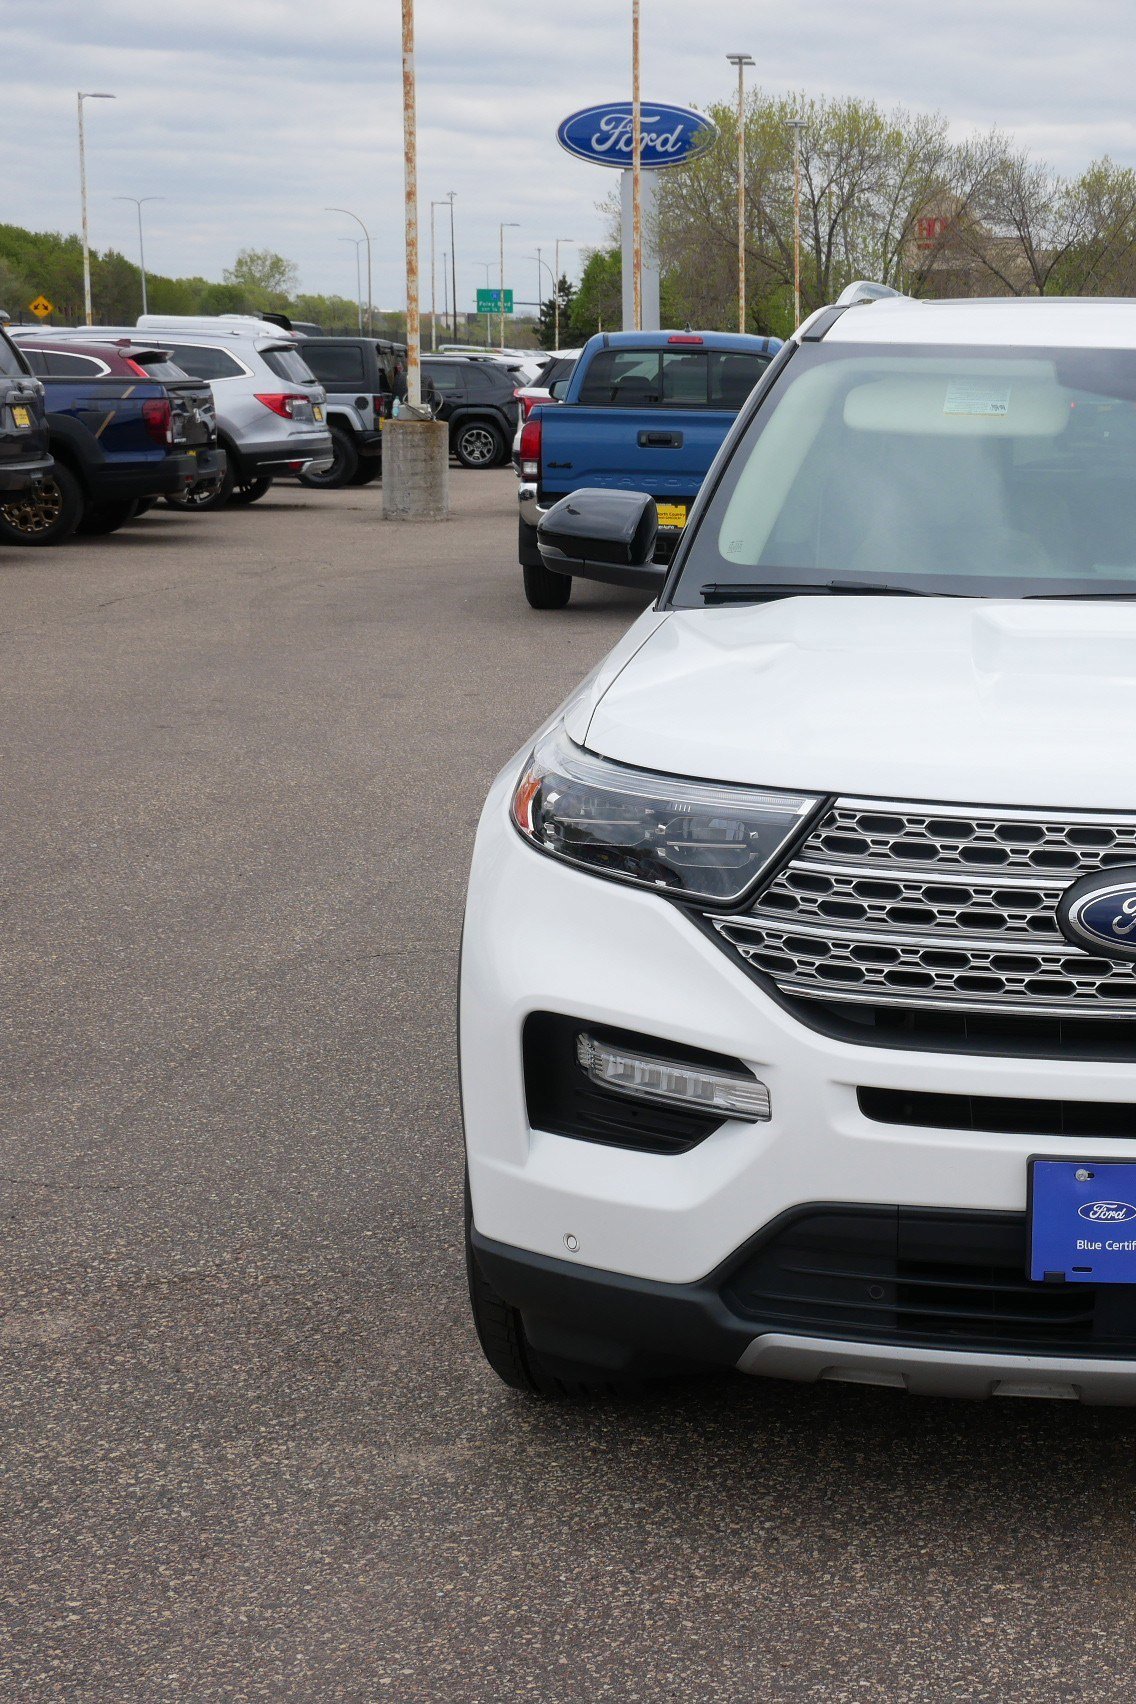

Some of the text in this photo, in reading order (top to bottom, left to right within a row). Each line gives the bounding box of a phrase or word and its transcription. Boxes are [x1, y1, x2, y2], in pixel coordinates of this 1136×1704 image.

[591, 114, 684, 153] Ford
[594, 476, 703, 487] TACOM
[1089, 1203, 1126, 1219] Ford
[1076, 1239, 1102, 1250] Blue
